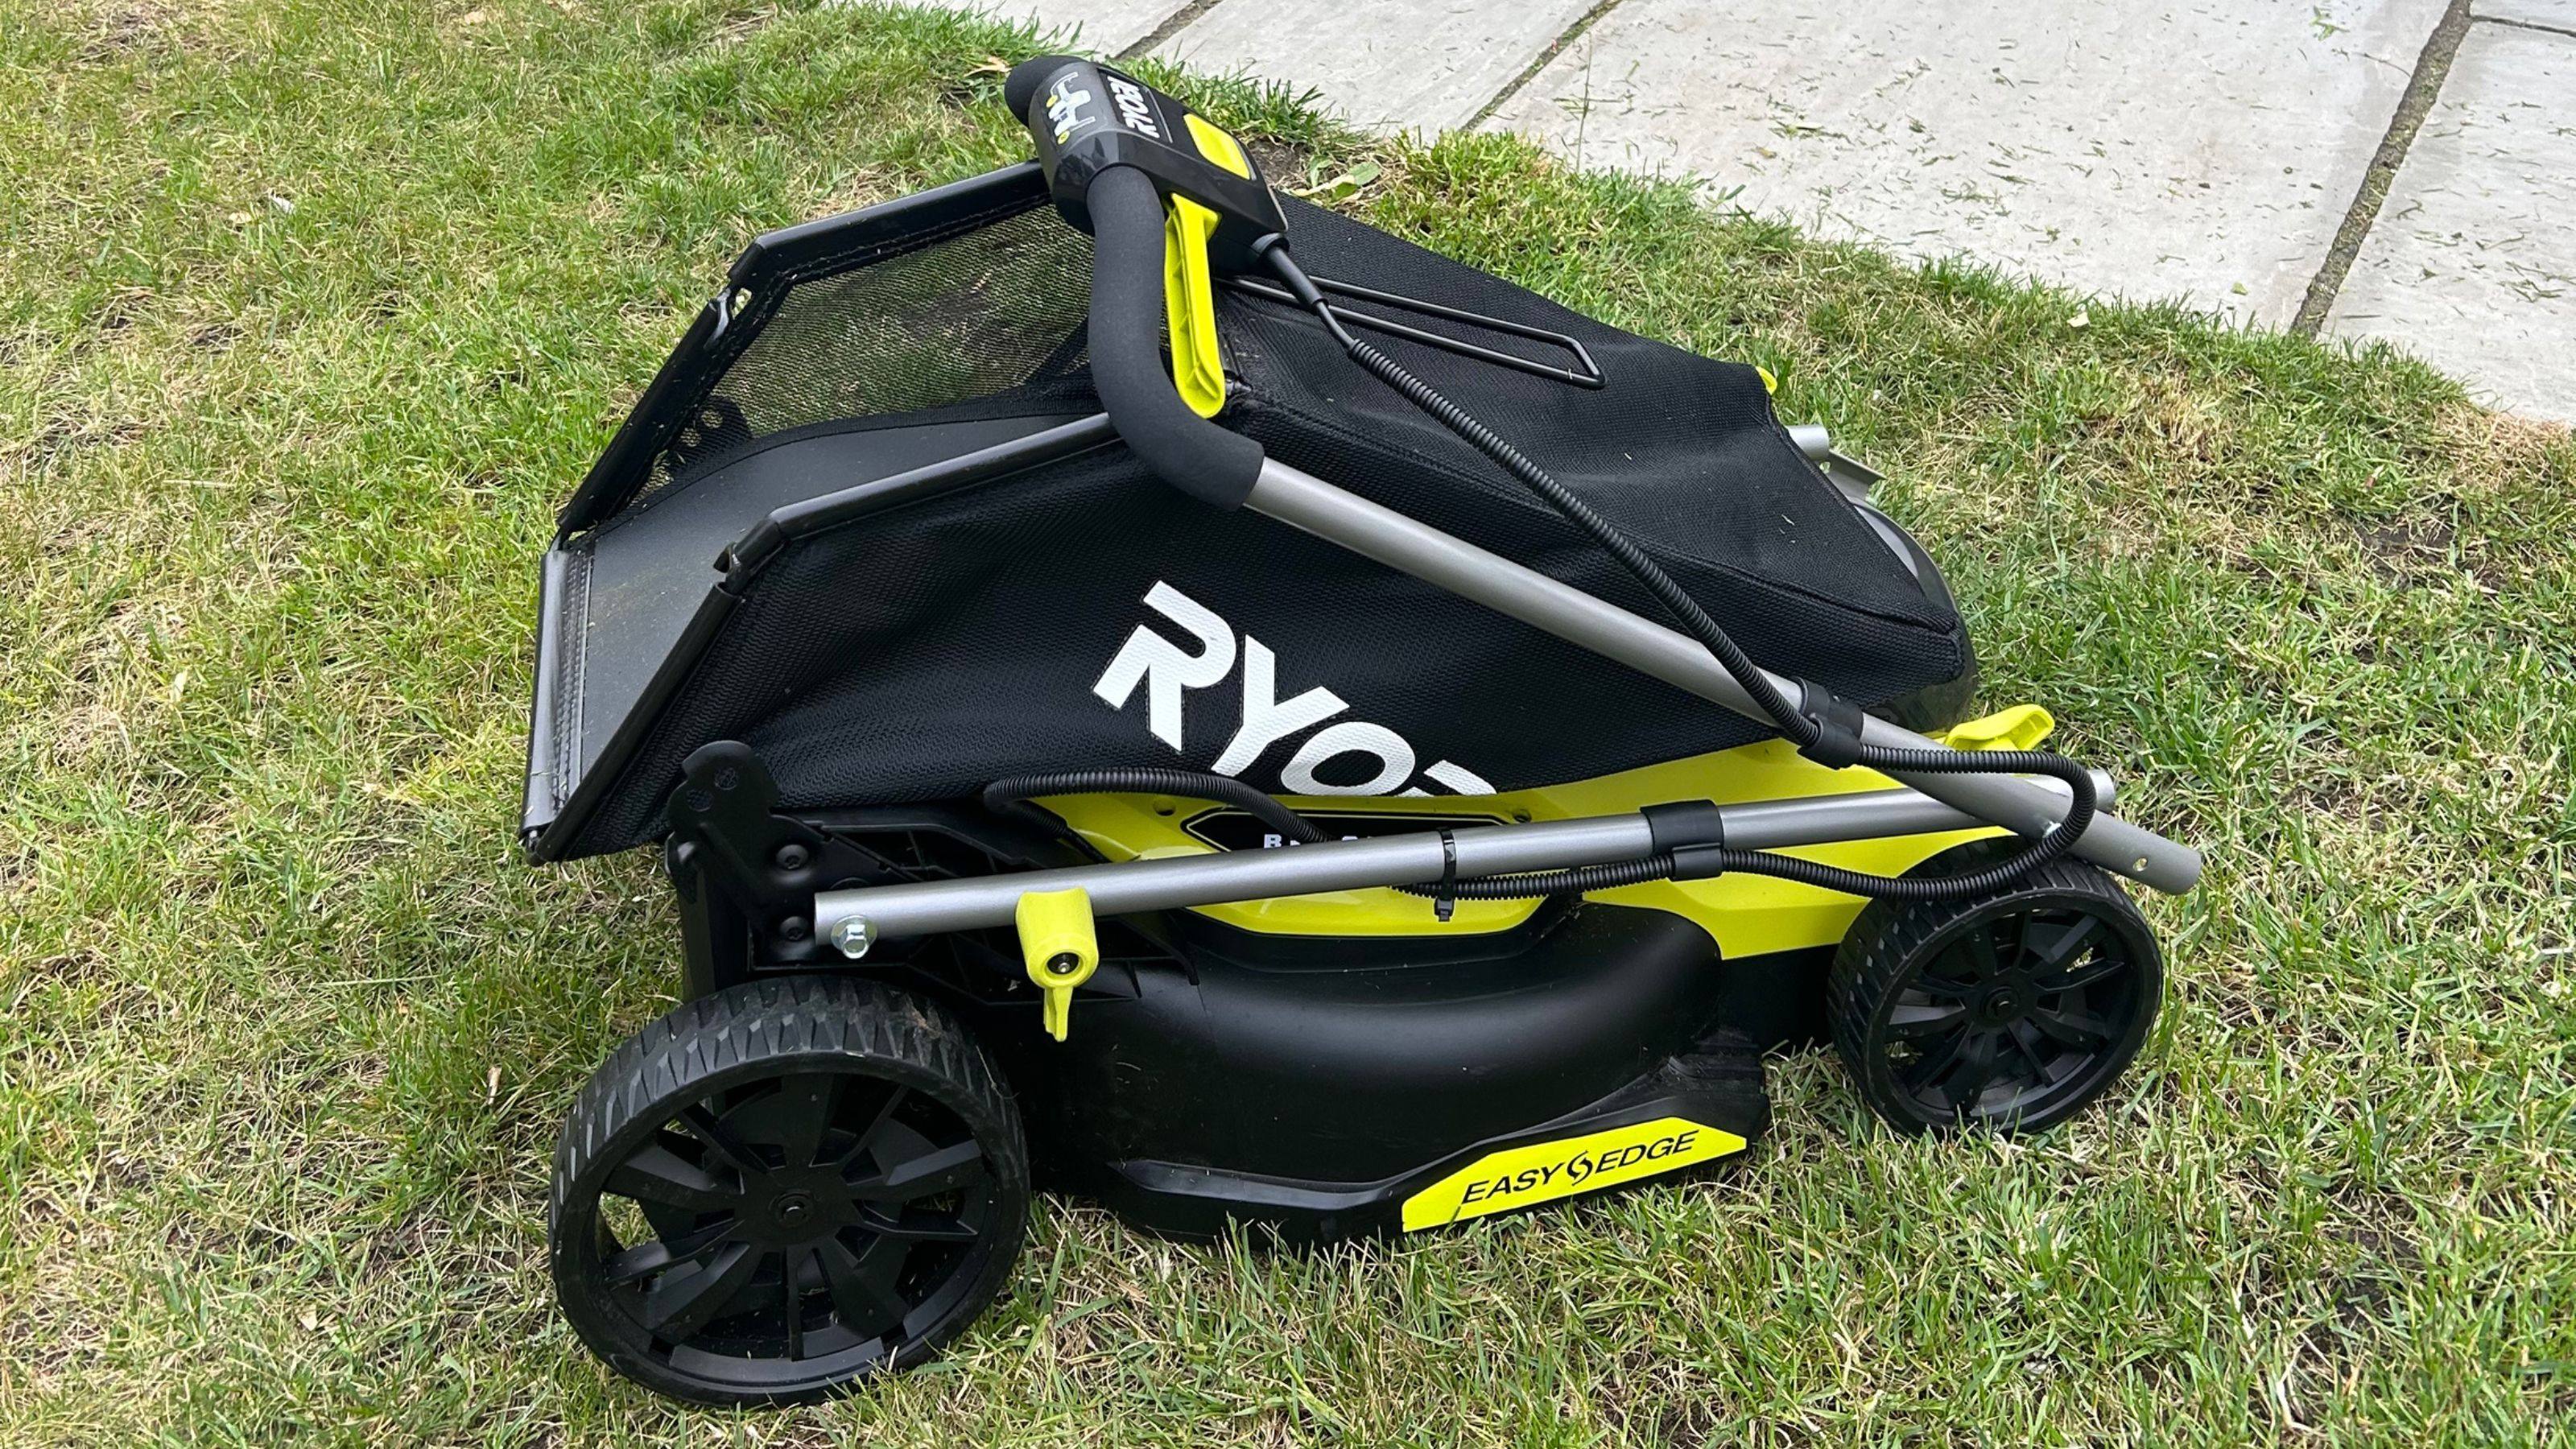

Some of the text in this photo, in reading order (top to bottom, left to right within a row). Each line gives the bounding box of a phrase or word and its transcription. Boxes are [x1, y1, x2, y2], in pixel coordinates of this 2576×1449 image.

[1107, 76, 1160, 138] RYOBI
[1461, 1129, 1700, 1205] EASY EDGE
